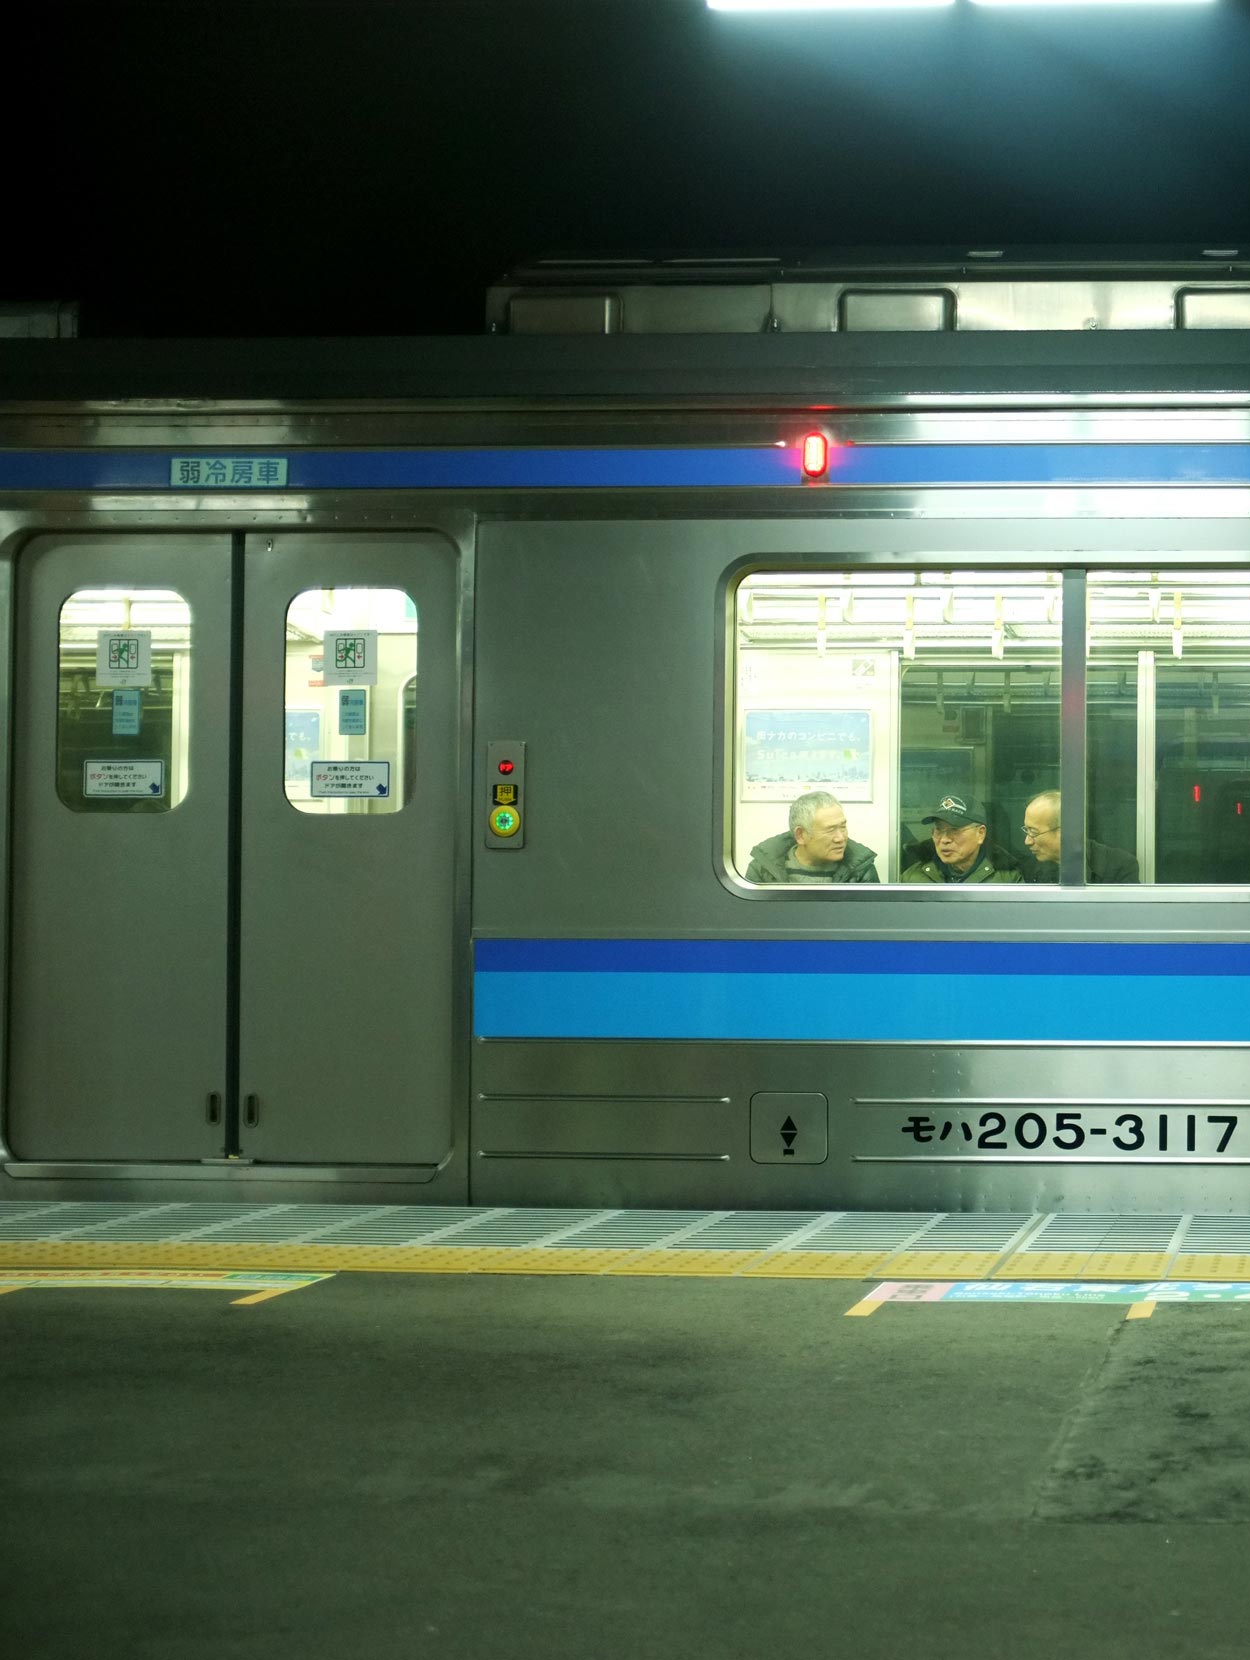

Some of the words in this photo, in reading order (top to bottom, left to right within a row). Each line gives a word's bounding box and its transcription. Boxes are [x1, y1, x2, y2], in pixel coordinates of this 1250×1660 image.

[179, 460, 280, 484] 弱冷房車
[499, 786, 512, 796] 押
